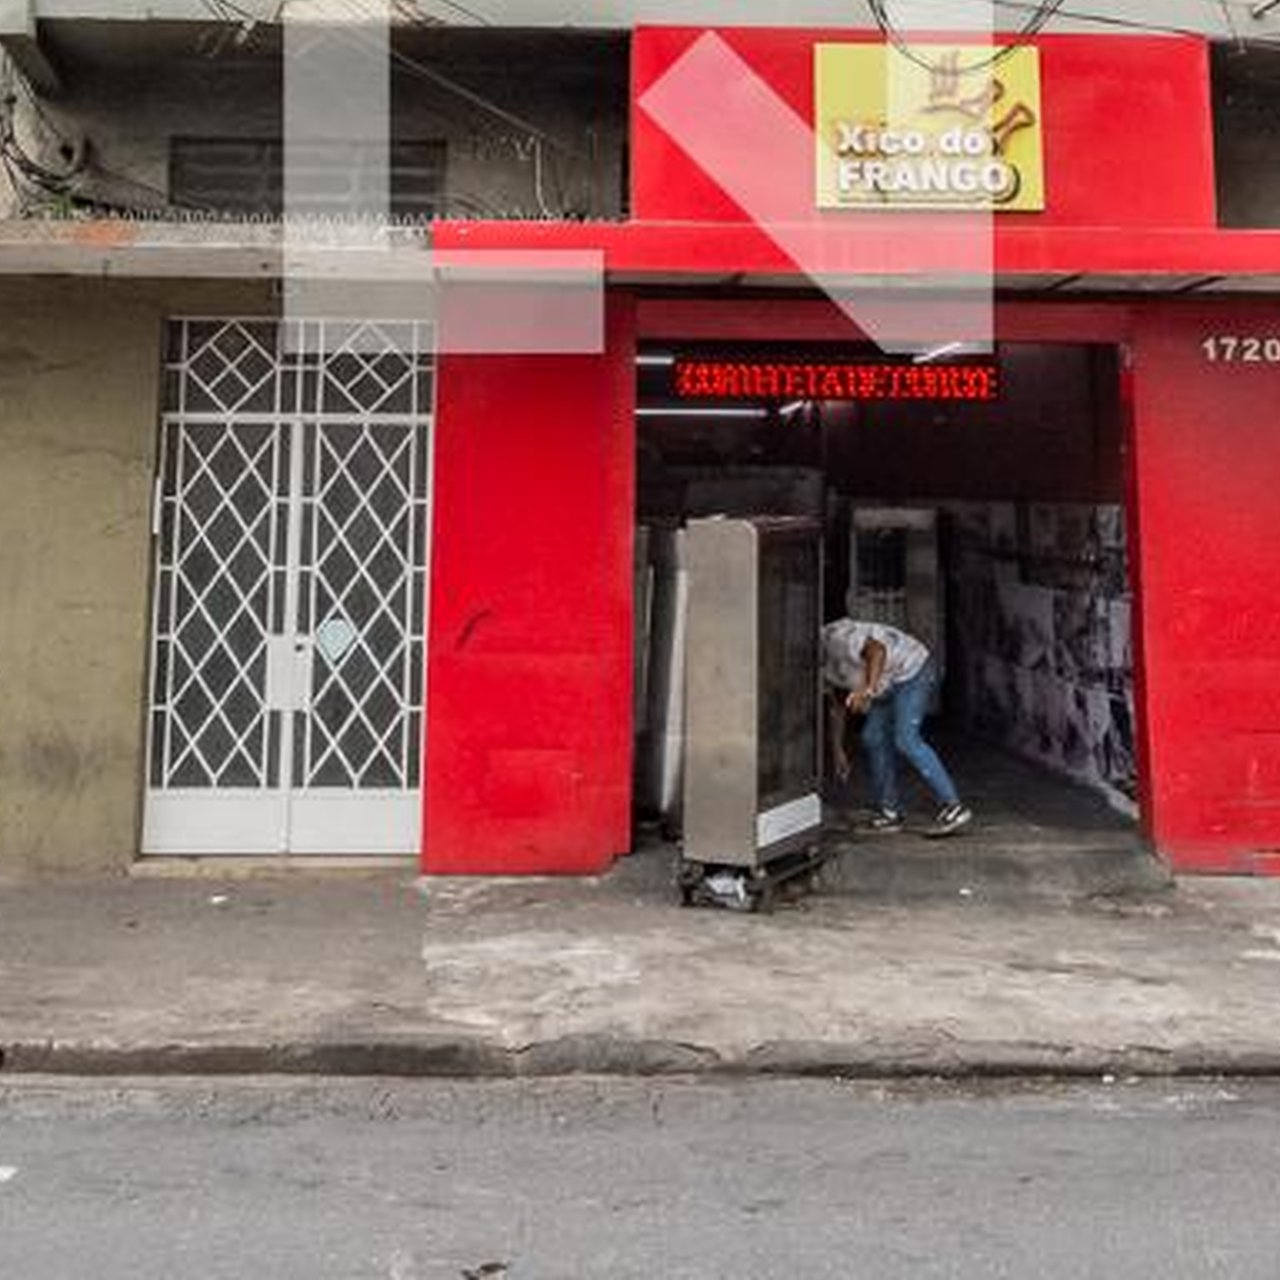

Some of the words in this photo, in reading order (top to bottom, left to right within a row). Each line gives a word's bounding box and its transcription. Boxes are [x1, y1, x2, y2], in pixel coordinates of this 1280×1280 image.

[836, 122, 924, 156] Xico
[939, 127, 988, 156] do
[837, 160, 1010, 195] FRANGO
